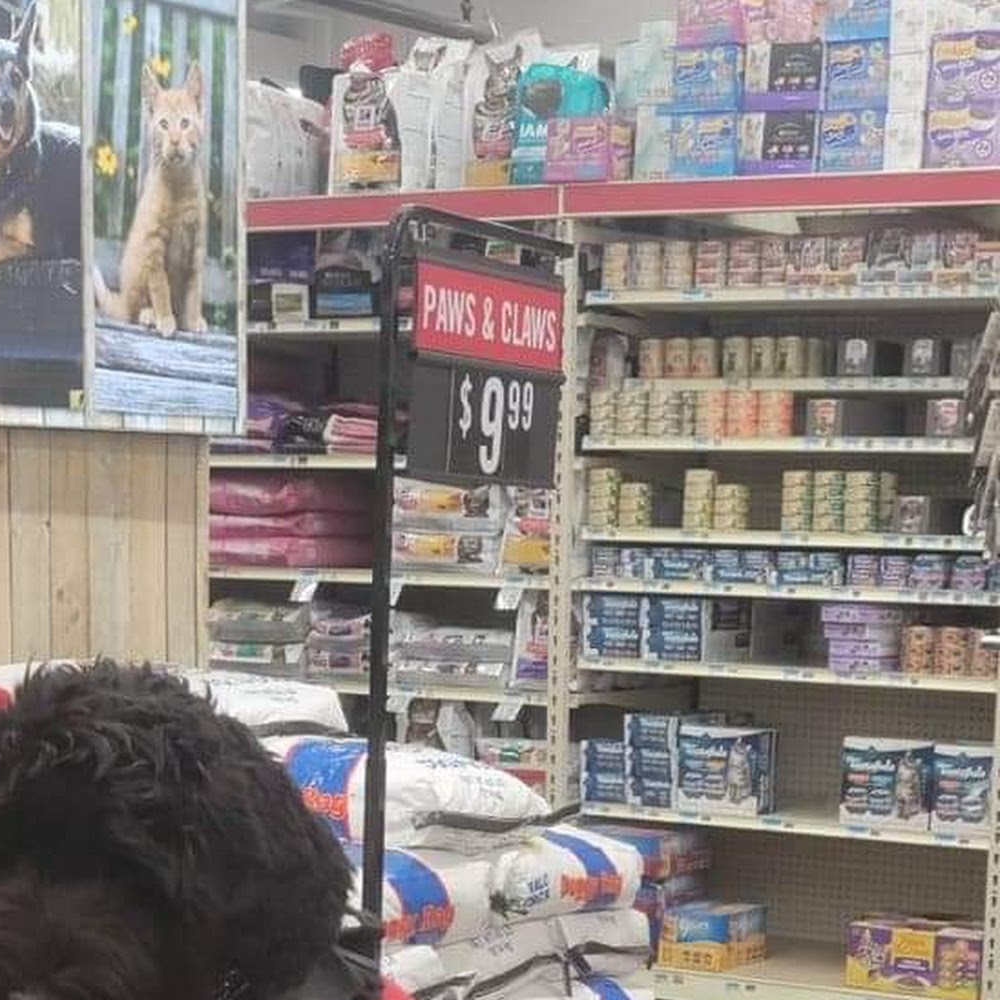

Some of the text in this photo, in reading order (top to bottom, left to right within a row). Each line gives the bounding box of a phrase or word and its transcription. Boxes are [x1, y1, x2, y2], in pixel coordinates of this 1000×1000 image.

[423, 285, 556, 351] PAWS & CLAWS
